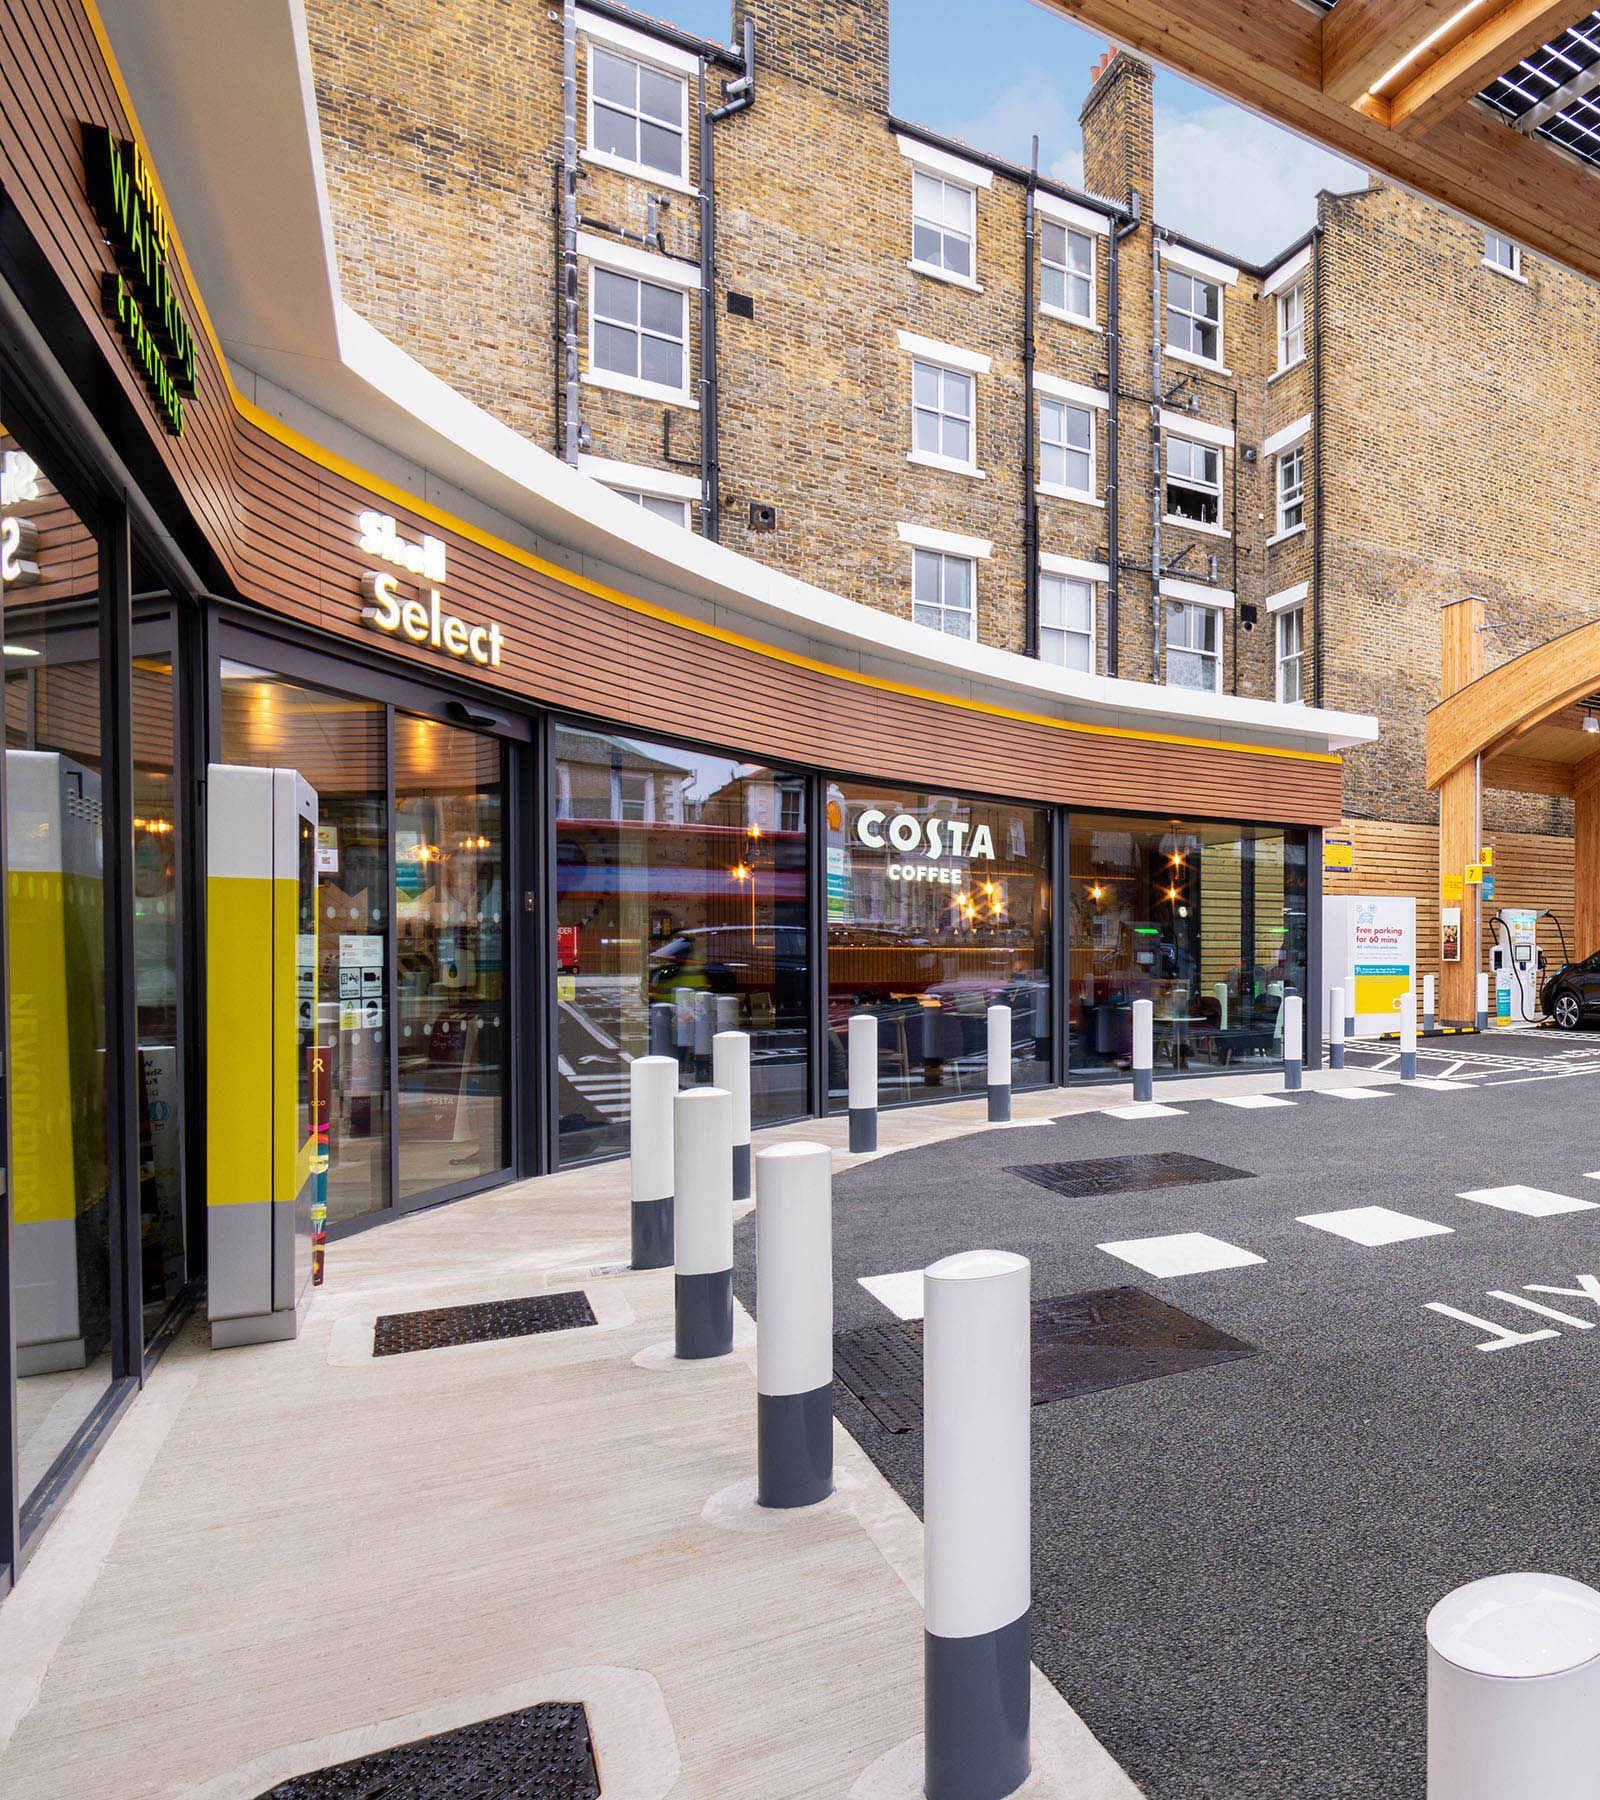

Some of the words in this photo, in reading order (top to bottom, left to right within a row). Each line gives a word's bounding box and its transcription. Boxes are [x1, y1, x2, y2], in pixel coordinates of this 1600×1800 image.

[108, 128, 200, 401] WAITROSE
[117, 273, 125, 323] &
[129, 296, 185, 439] PARTNERS
[359, 509, 446, 583] Shell
[373, 572, 505, 668] Select
[857, 809, 996, 861] COSTA
[887, 863, 963, 885] COFFEE
[1356, 926, 1372, 934] Free
[1374, 926, 1403, 937] parking
[1356, 935, 1367, 943] for
[1369, 935, 1379, 944] 60
[1380, 935, 1398, 944] mins
